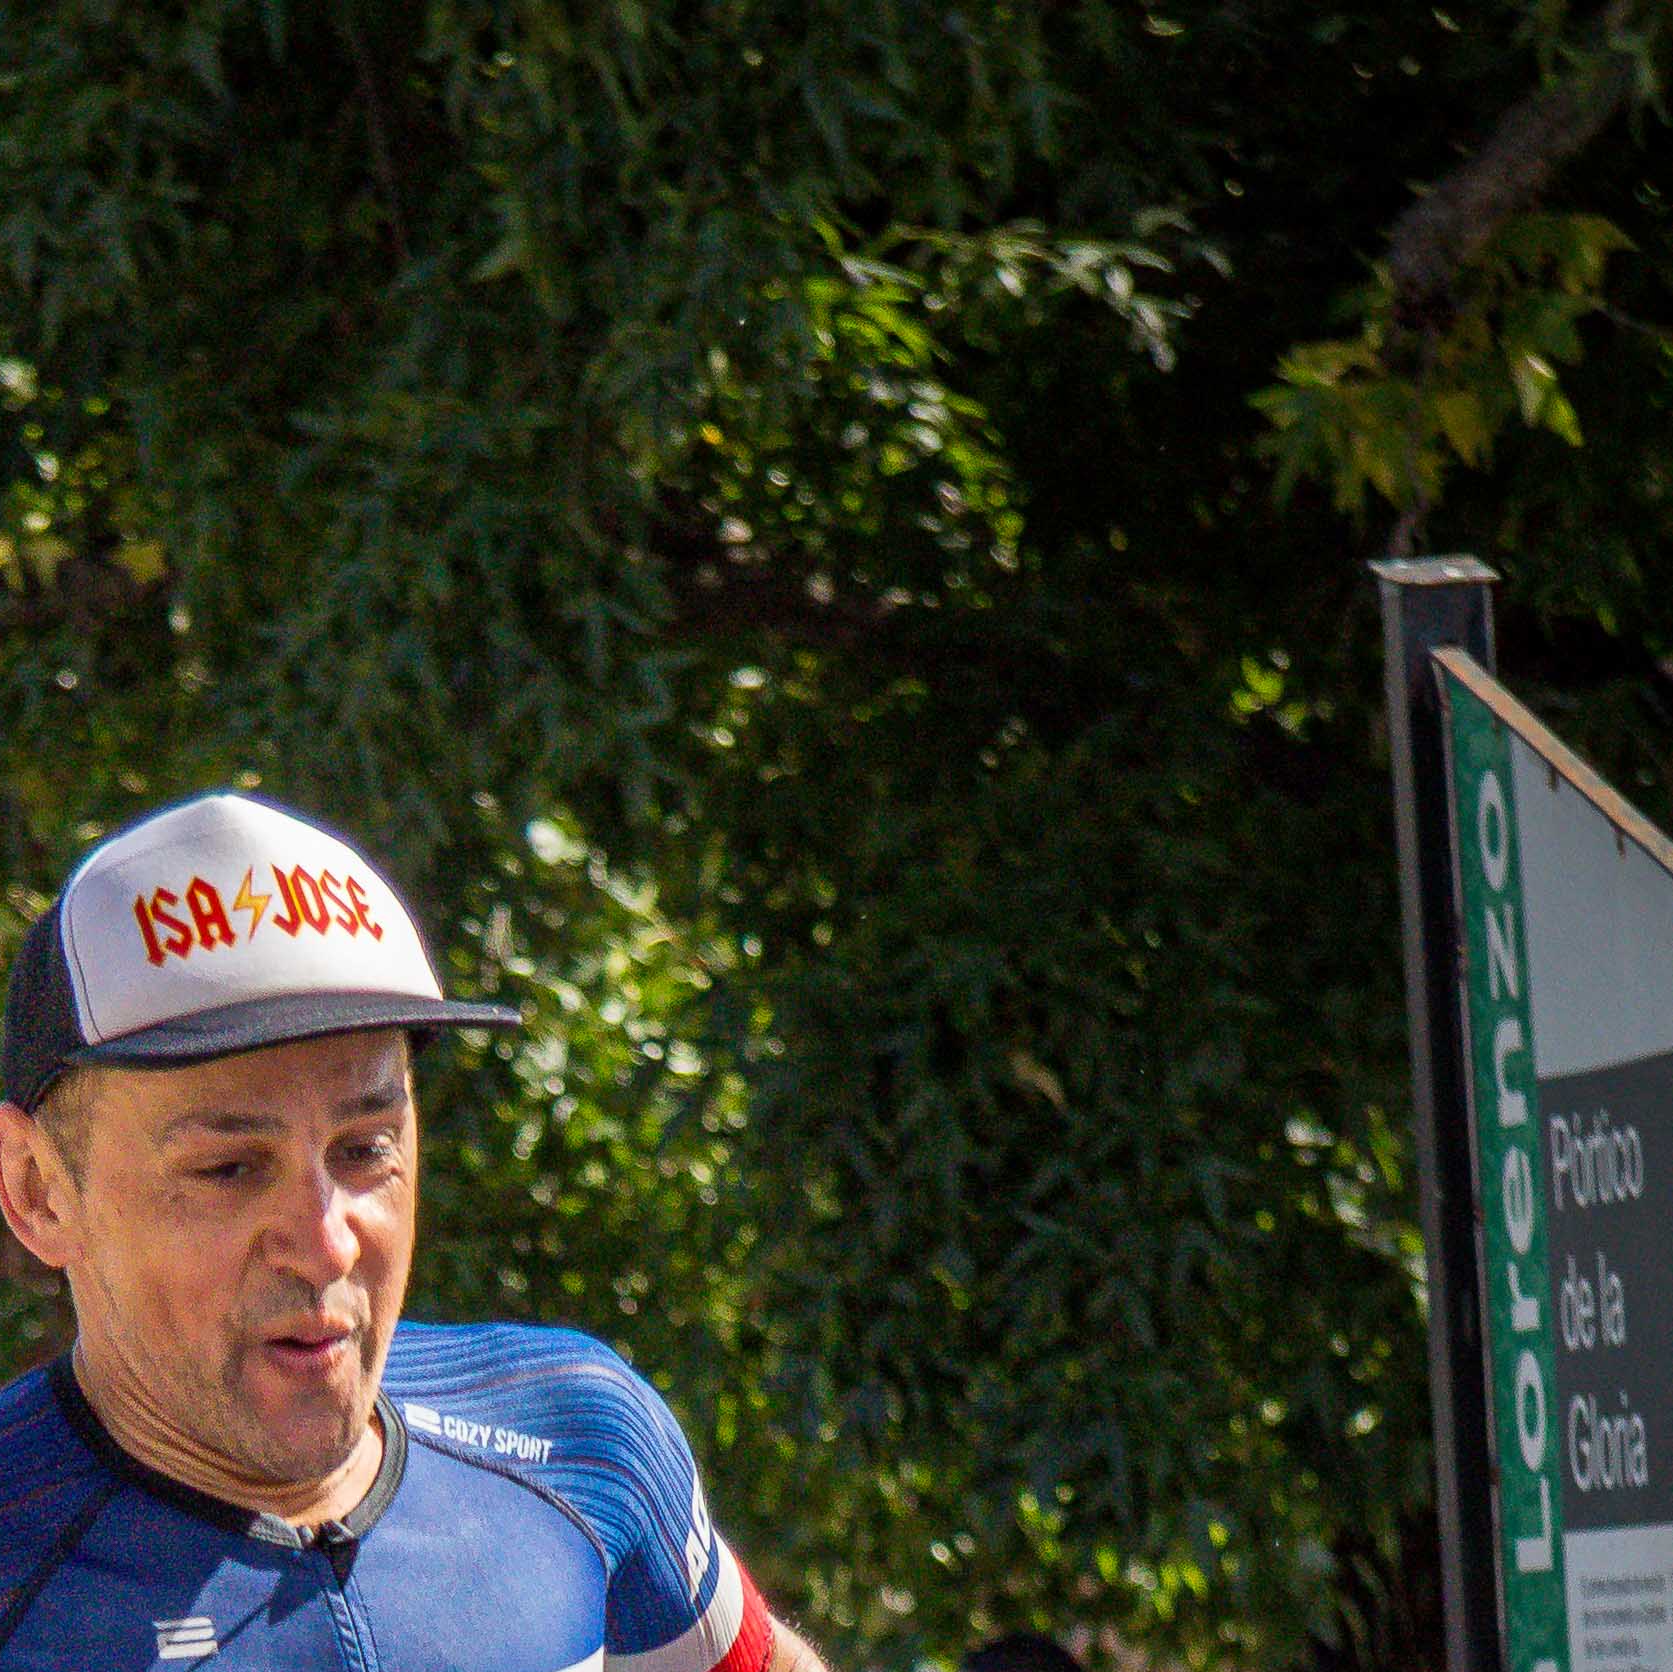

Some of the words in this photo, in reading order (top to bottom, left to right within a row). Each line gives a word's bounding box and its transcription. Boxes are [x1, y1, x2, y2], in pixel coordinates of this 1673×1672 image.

[132, 876, 237, 968] ISA
[270, 862, 384, 943] JOSE
[1476, 769, 1555, 1573] Lorenzo
[1560, 1254, 1596, 1351] de
[1597, 1250, 1626, 1348] la
[443, 1414, 492, 1449] COZY
[494, 1427, 553, 1465] SPORT
[1567, 1391, 1650, 1493] Gloria
